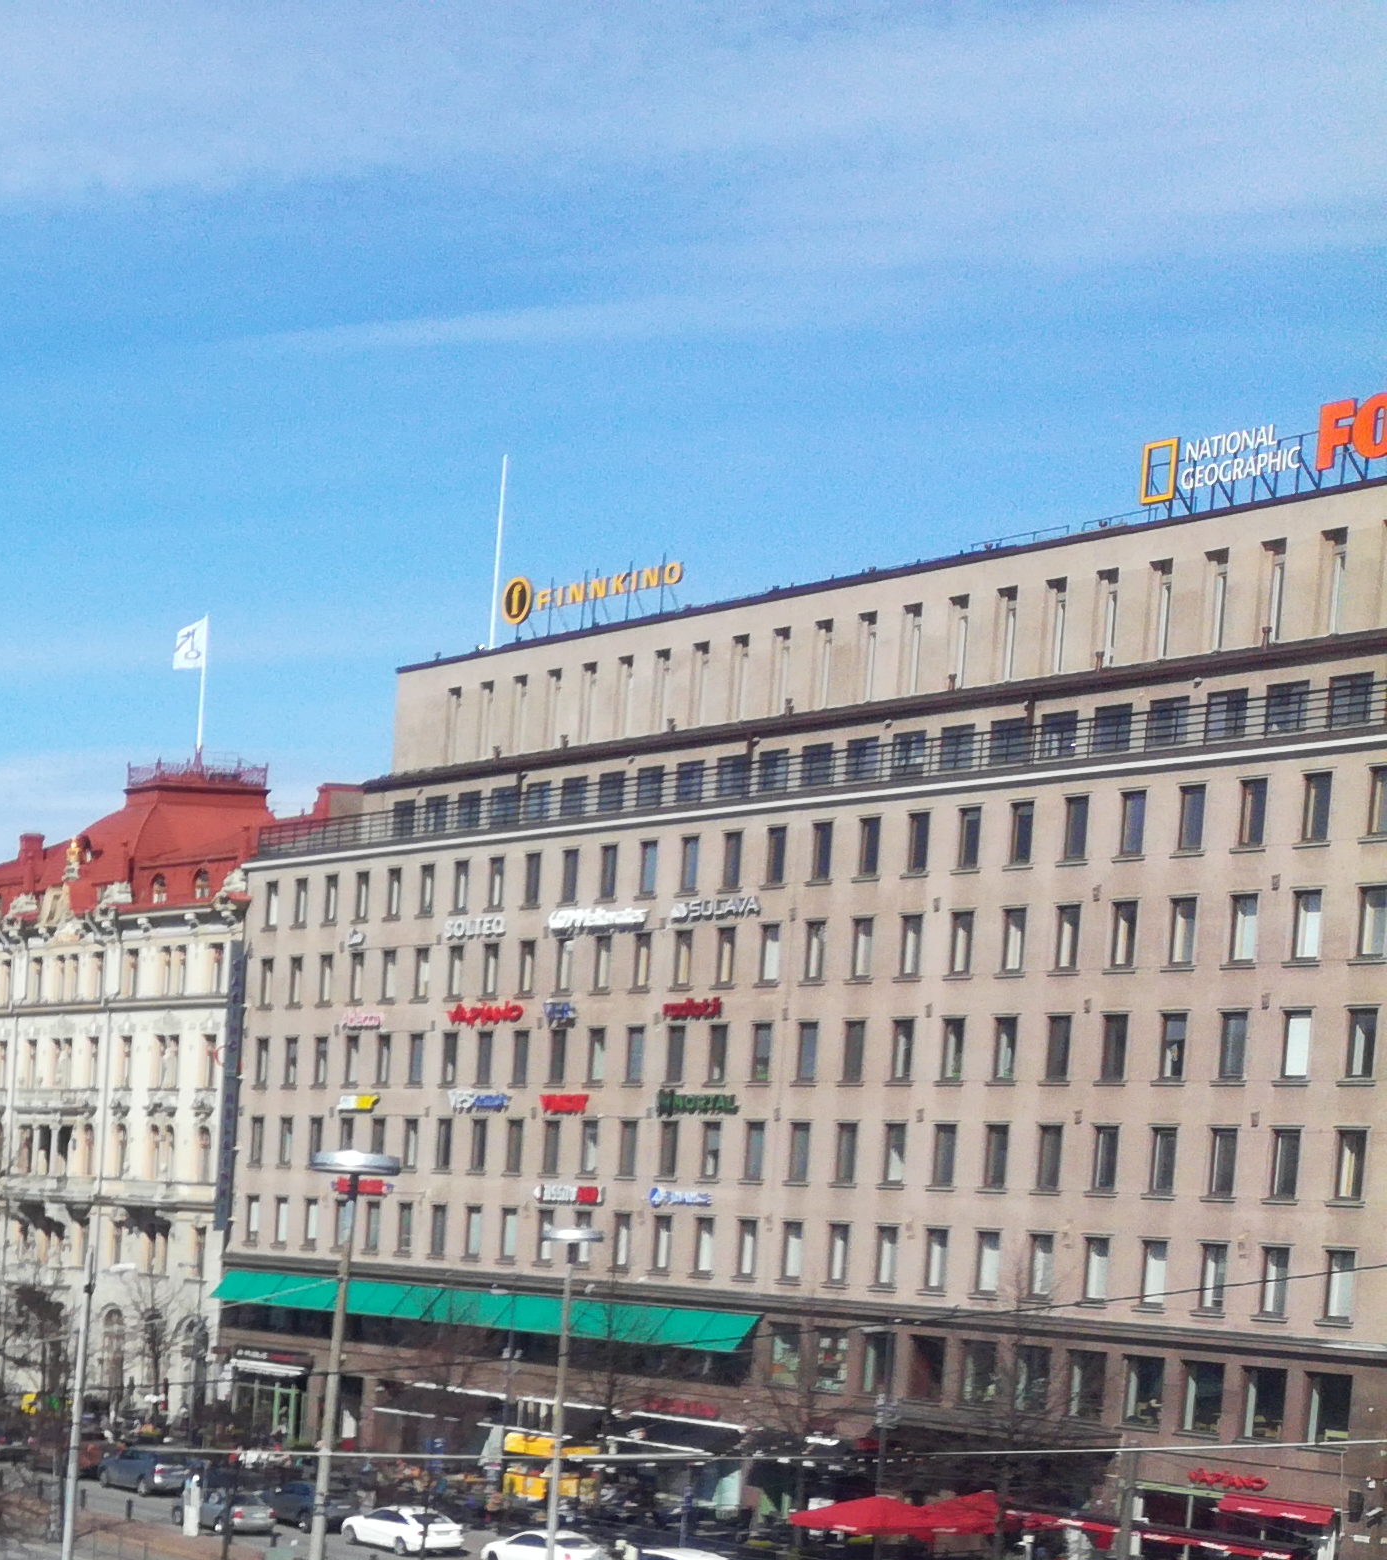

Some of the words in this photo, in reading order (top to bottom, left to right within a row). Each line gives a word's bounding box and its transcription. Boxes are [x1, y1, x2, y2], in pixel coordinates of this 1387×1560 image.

[1185, 424, 1277, 463] NATIONAL
[1181, 446, 1301, 489] GEOGRAPHIC
[536, 561, 684, 611] FINNKINO
[444, 915, 506, 939] SOLTEQ
